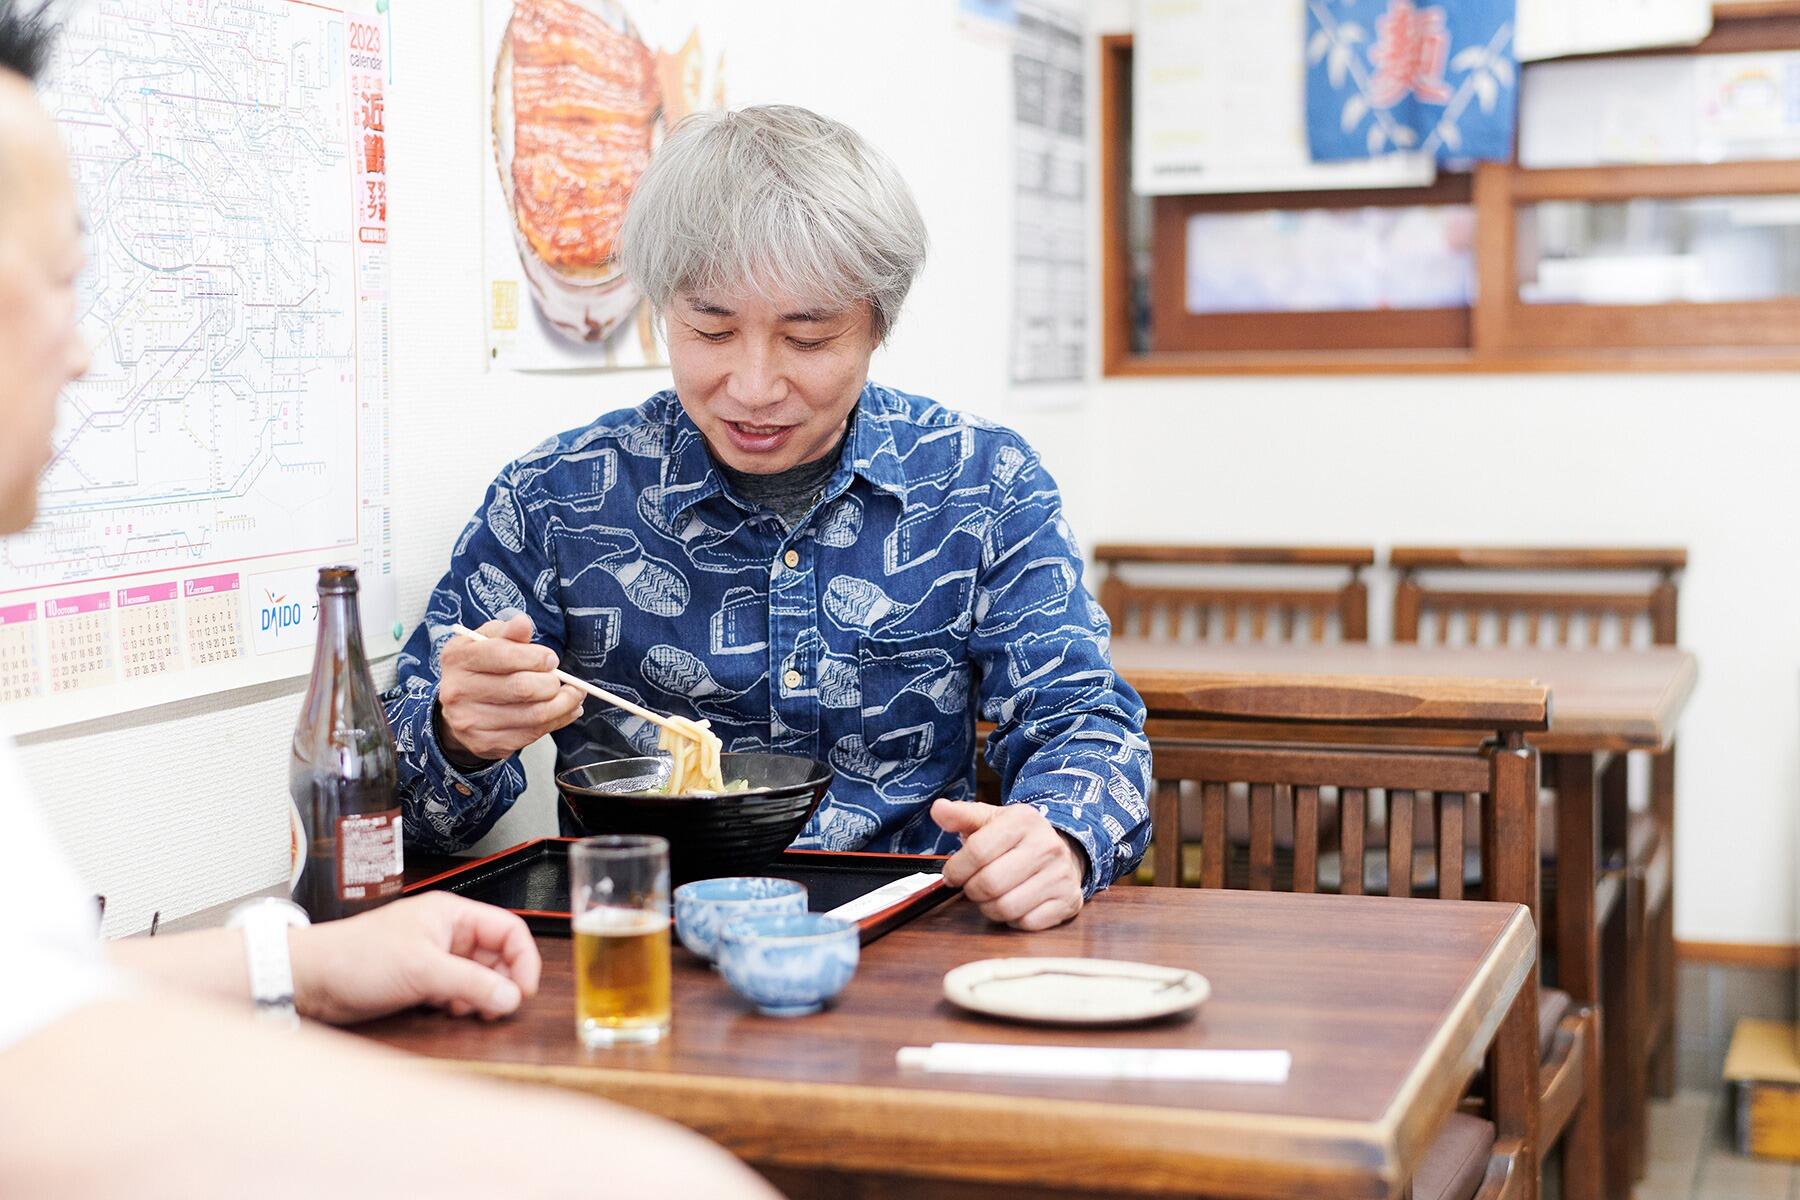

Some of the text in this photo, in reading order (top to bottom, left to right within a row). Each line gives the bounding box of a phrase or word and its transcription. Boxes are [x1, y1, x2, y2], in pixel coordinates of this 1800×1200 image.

[349, 22, 381, 53] 2023
[185, 580, 194, 596] 12
[118, 589, 128, 606] 11
[46, 600, 57, 617] 10
[262, 603, 301, 637] DAIDO
